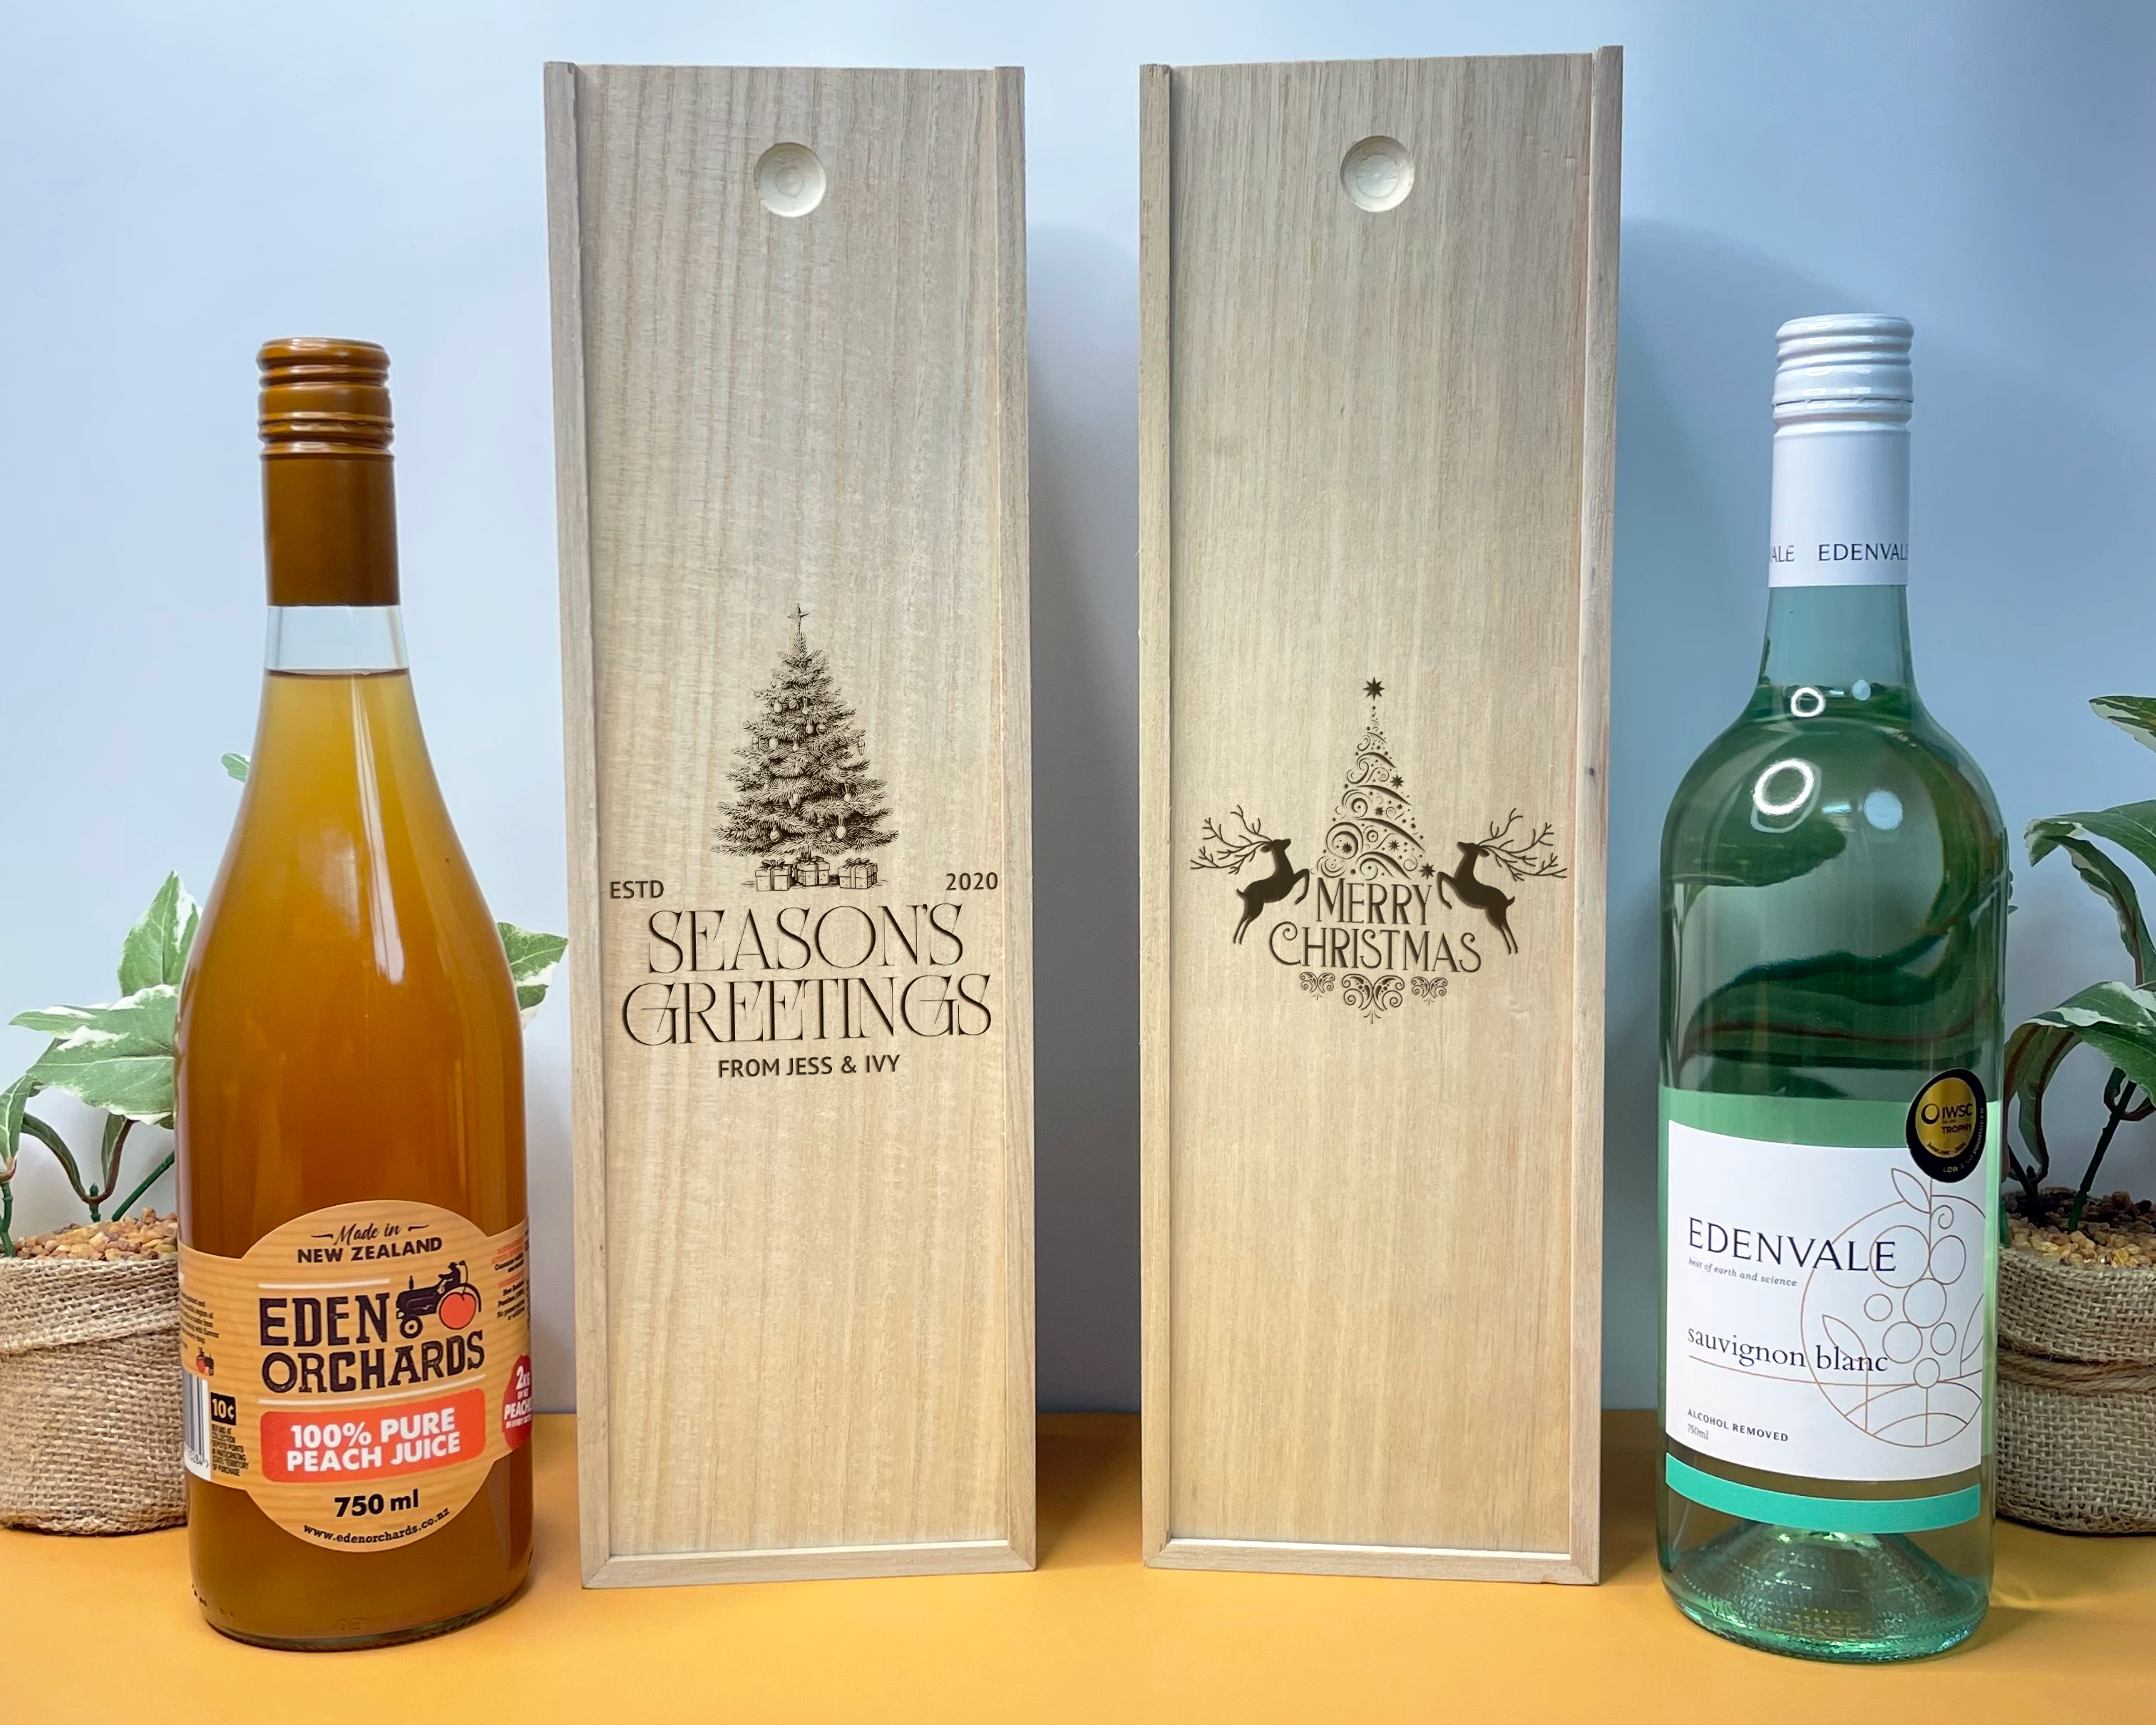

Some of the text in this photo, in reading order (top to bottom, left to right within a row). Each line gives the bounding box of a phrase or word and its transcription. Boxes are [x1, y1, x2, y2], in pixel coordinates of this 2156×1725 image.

[610, 879, 664, 900] ESTD
[945, 871, 998, 891] 2020
[1315, 877, 1433, 926] MERRY
[648, 903, 964, 974] SEASON'S
[1269, 921, 1482, 973] CHRISTMAS
[622, 973, 992, 1046] GREETINGS
[718, 1054, 900, 1078] FROM JESS & IVY
[1941, 1123, 1972, 1135] TROPHY
[1942, 1103, 1973, 1120] IWSC
[297, 1237, 443, 1263] NEW ZEALAND
[333, 1222, 402, 1246] Made in
[1688, 1216, 1896, 1272] EDENVALE
[1688, 1256, 1797, 1286] best of earth and science
[259, 1292, 391, 1347] EDEN
[262, 1329, 485, 1393] ORCHARDS
[1687, 1326, 1889, 1372] sauvignon blanc
[290, 1407, 456, 1449] 100% PURE
[1687, 1423, 1709, 1440] 750ml
[1688, 1408, 1789, 1442] ALCOHOL REMOVED
[287, 1431, 461, 1472] PEACH JUICE
[334, 1488, 419, 1517] 750 ml
[304, 1508, 451, 1544] www.edenorchards.co.nz
